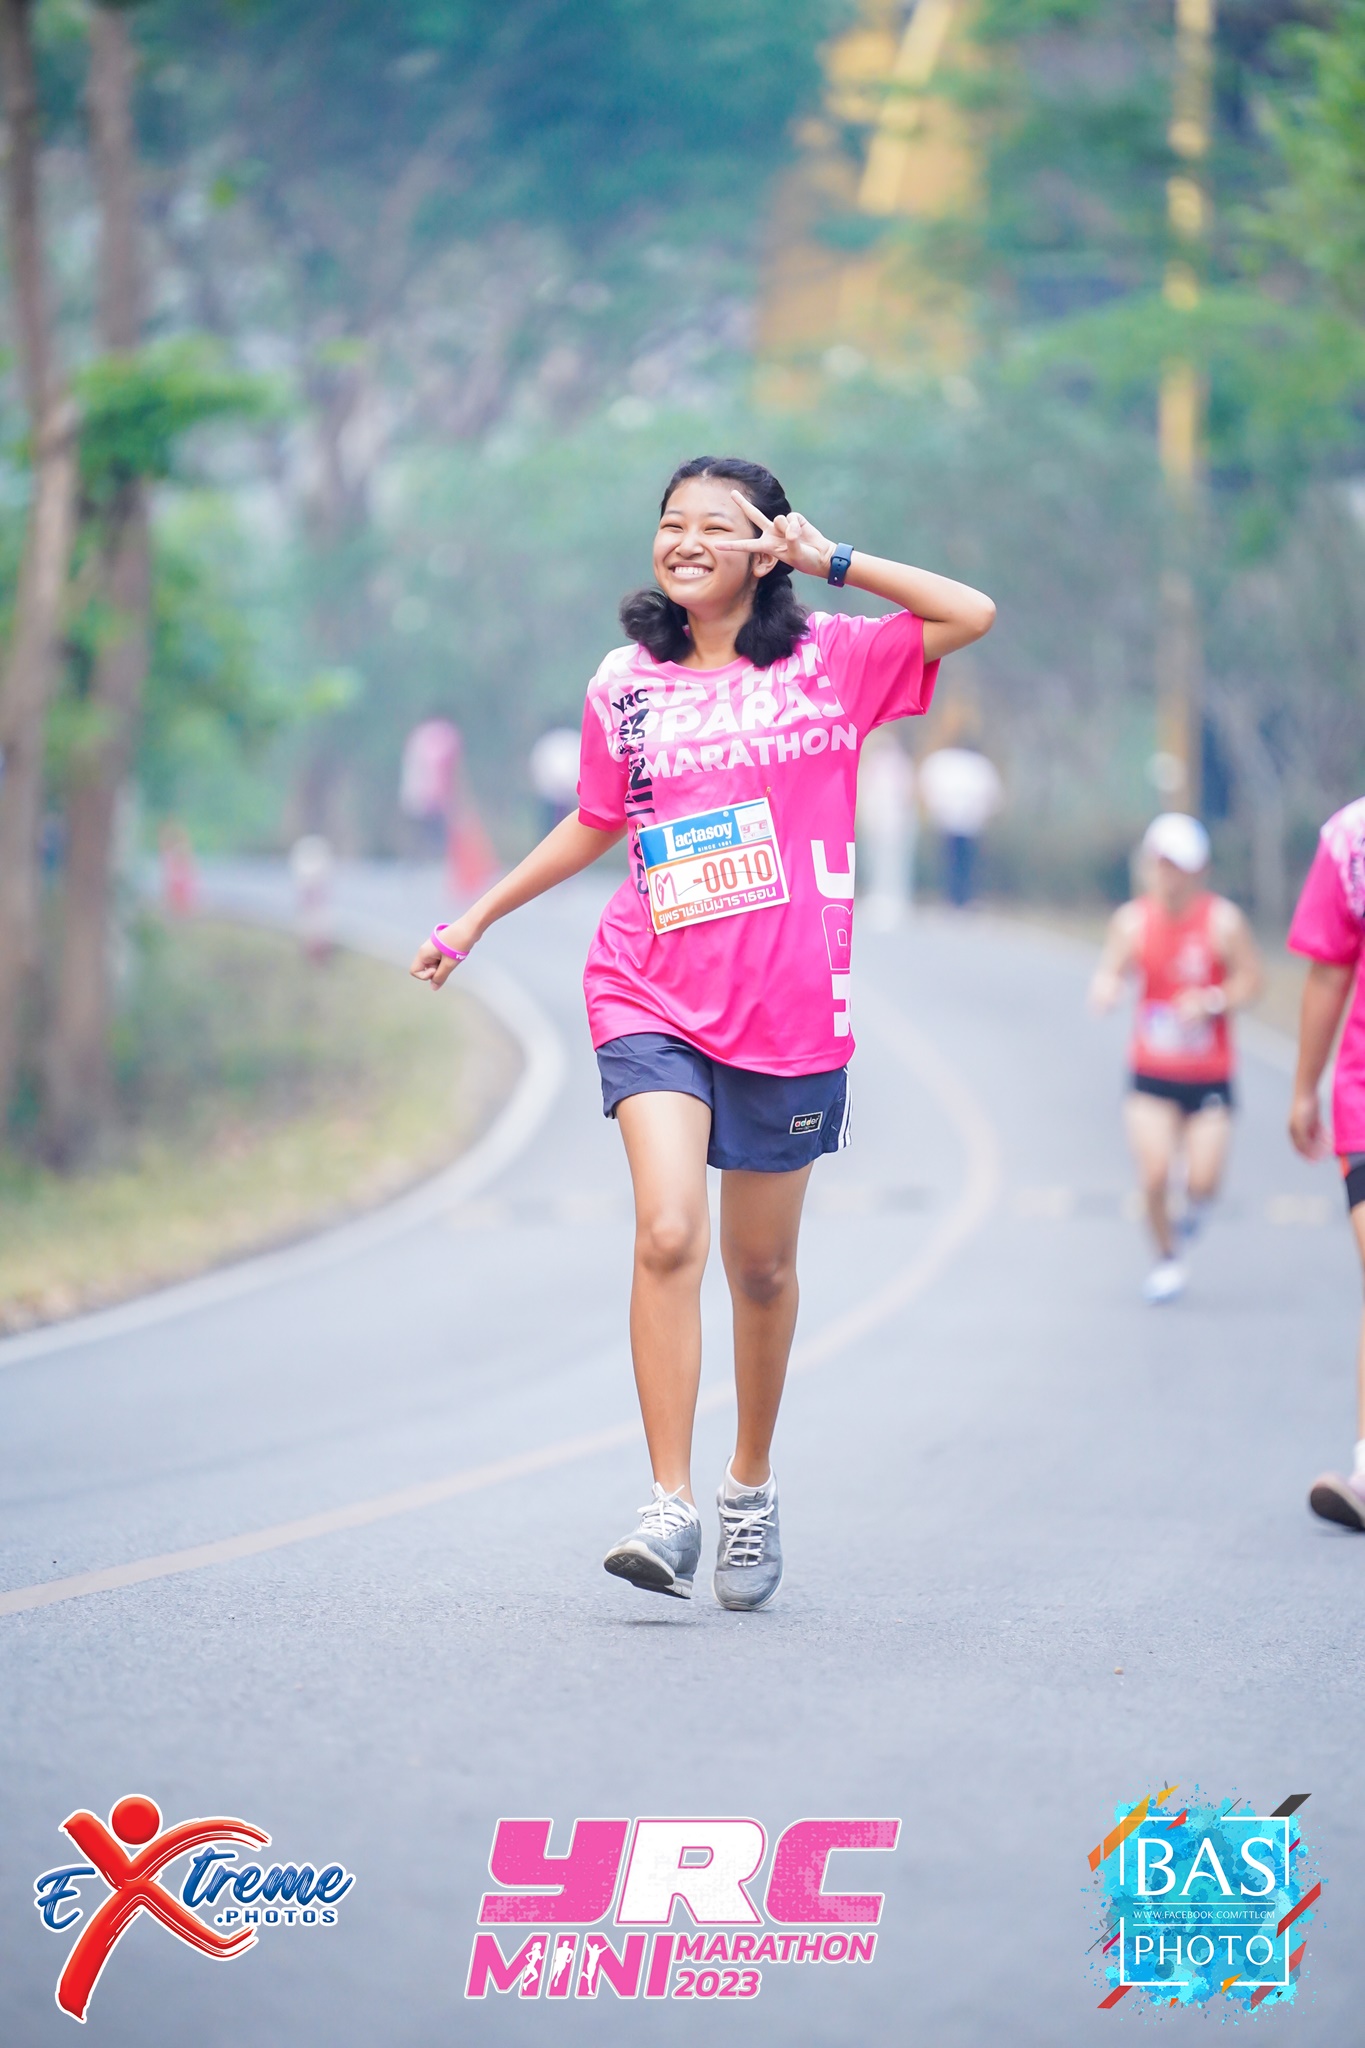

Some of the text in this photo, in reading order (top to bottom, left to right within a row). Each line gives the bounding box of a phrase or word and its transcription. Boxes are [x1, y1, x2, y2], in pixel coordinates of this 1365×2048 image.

[612, 688, 649, 713] YRC
[640, 723, 858, 779] MARATHON
[662, 821, 733, 860] Lactasoy
